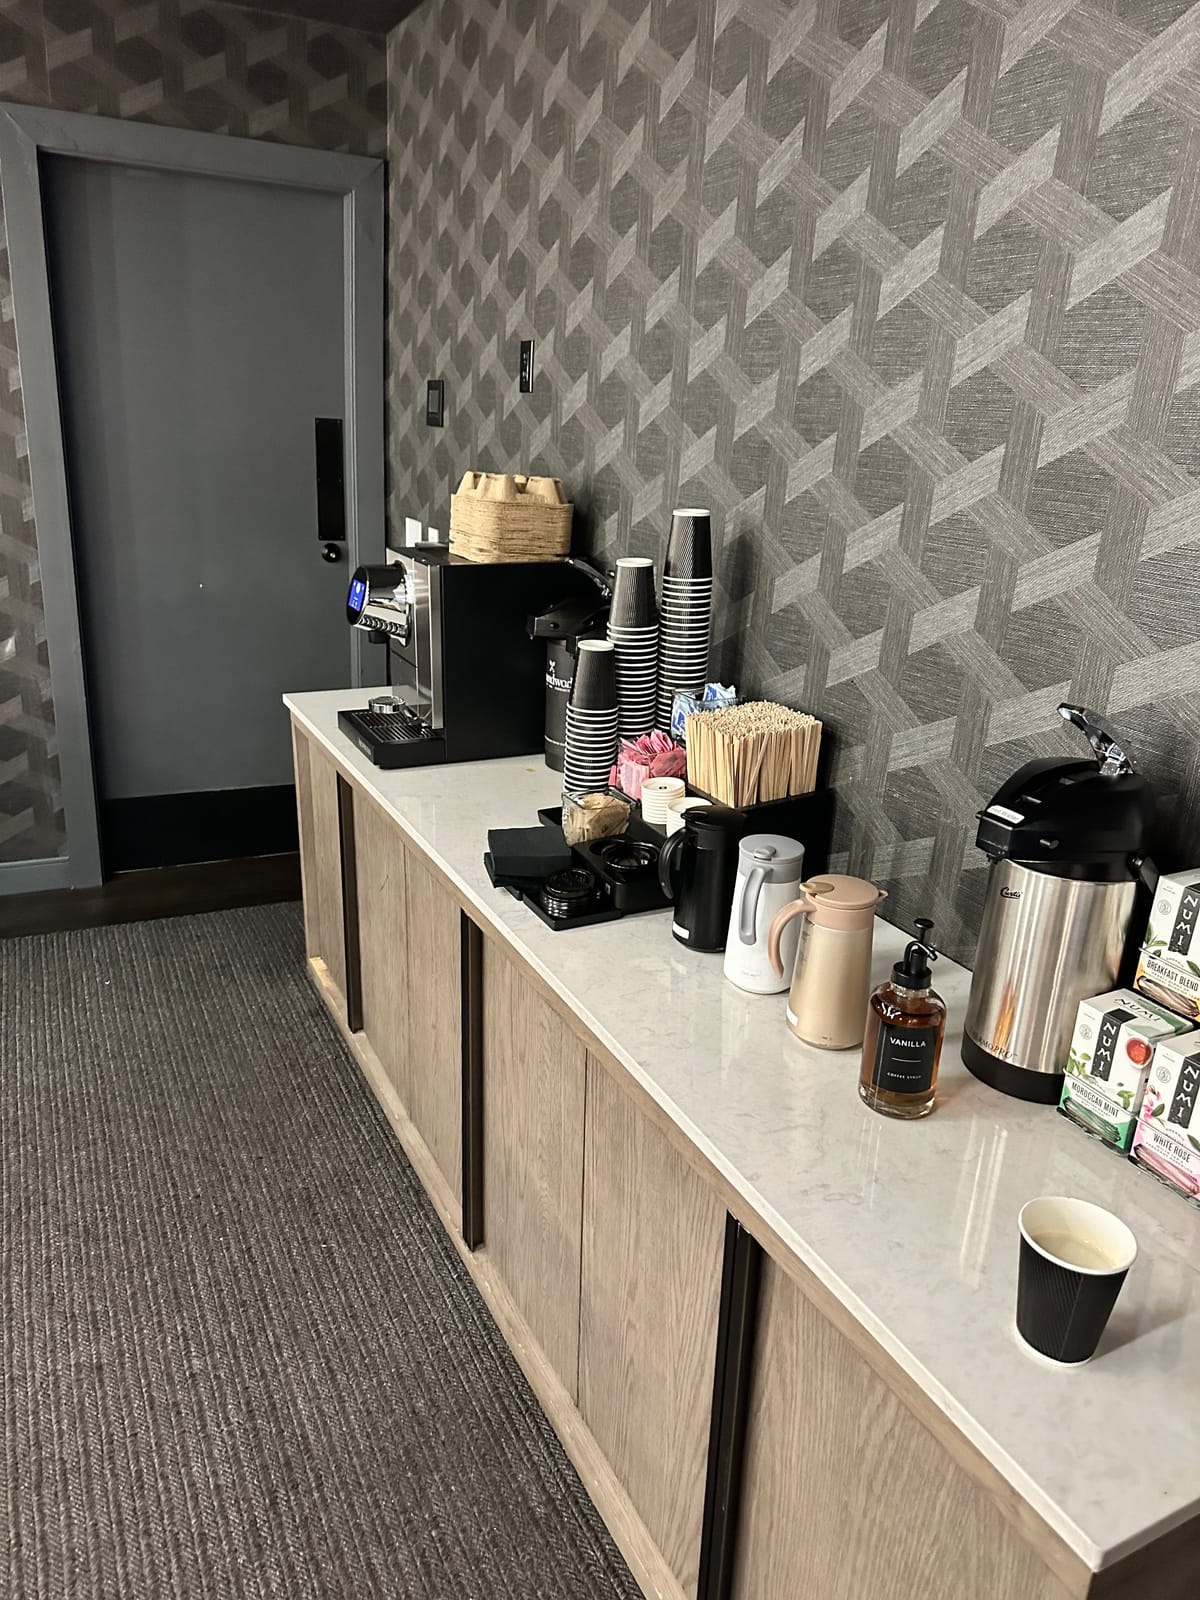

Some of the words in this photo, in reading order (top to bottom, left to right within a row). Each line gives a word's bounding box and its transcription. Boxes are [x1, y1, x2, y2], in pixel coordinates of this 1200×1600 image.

[1176, 894, 1199, 946] NUMI
[1146, 959, 1179, 982] BREAKFAST
[1178, 975, 1199, 992] BLEND
[1113, 998, 1161, 1022] NUMI
[889, 1036, 927, 1048] VANILLA
[1097, 1022, 1117, 1072] NUMI
[1071, 1081, 1104, 1108] MOROCCAN
[1103, 1102, 1120, 1118] MINT
[1175, 1065, 1200, 1118] NUMI
[1153, 1132, 1173, 1152] WHITE
[1173, 1144, 1191, 1163] ROSE
